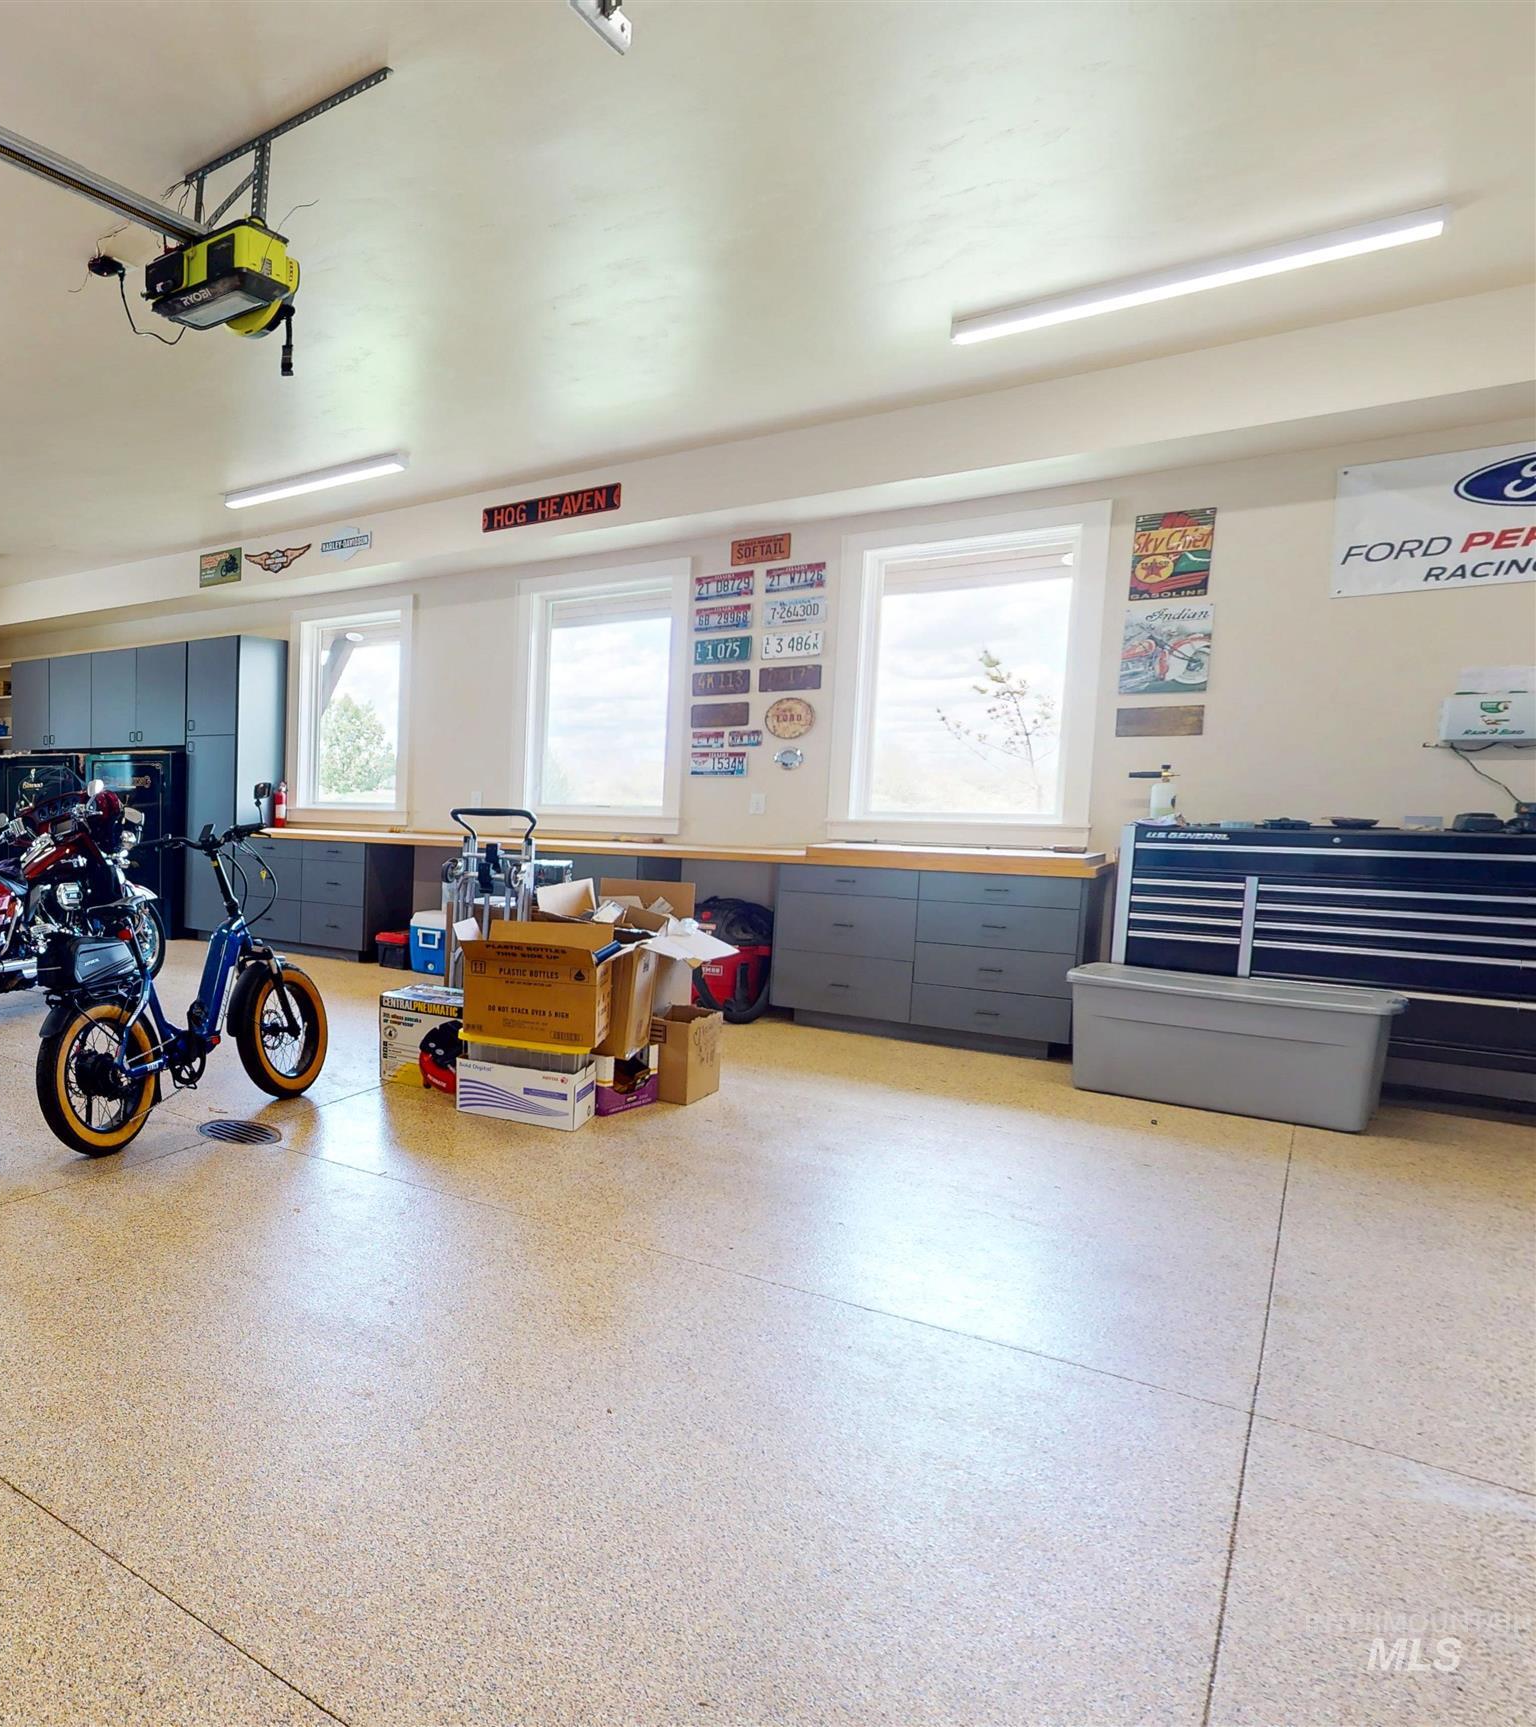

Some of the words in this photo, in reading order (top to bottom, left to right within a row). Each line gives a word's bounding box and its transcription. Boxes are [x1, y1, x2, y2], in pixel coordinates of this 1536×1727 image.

[180, 287, 212, 306] RYOBI
[493, 504, 527, 528] HOG
[537, 488, 607, 520] HEAVEN
[1134, 531, 1166, 553] Sky
[1167, 527, 1213, 551] Chief
[736, 542, 785, 560] SOFTAIL
[1340, 535, 1453, 566] FORD
[1423, 556, 1536, 582] RACIN
[769, 575, 781, 587] 2T
[697, 582, 710, 596] 2T
[1129, 588, 1207, 600] GASOLINE
[1145, 607, 1210, 621] Indian
[711, 756, 745, 771] 1534M
[1168, 831, 1230, 841] GENERAL
[485, 944, 524, 952] PLASTIC
[525, 946, 568, 955] BOTTLES
[498, 967, 527, 977] PLASTIC
[529, 969, 559, 980] BOTTLES
[488, 1004, 496, 1012] DO
[498, 1005, 509, 1013] NOT
[511, 1007, 529, 1015] STACK
[531, 1009, 546, 1017] OVER
[554, 1010, 569, 1019] HIGH
